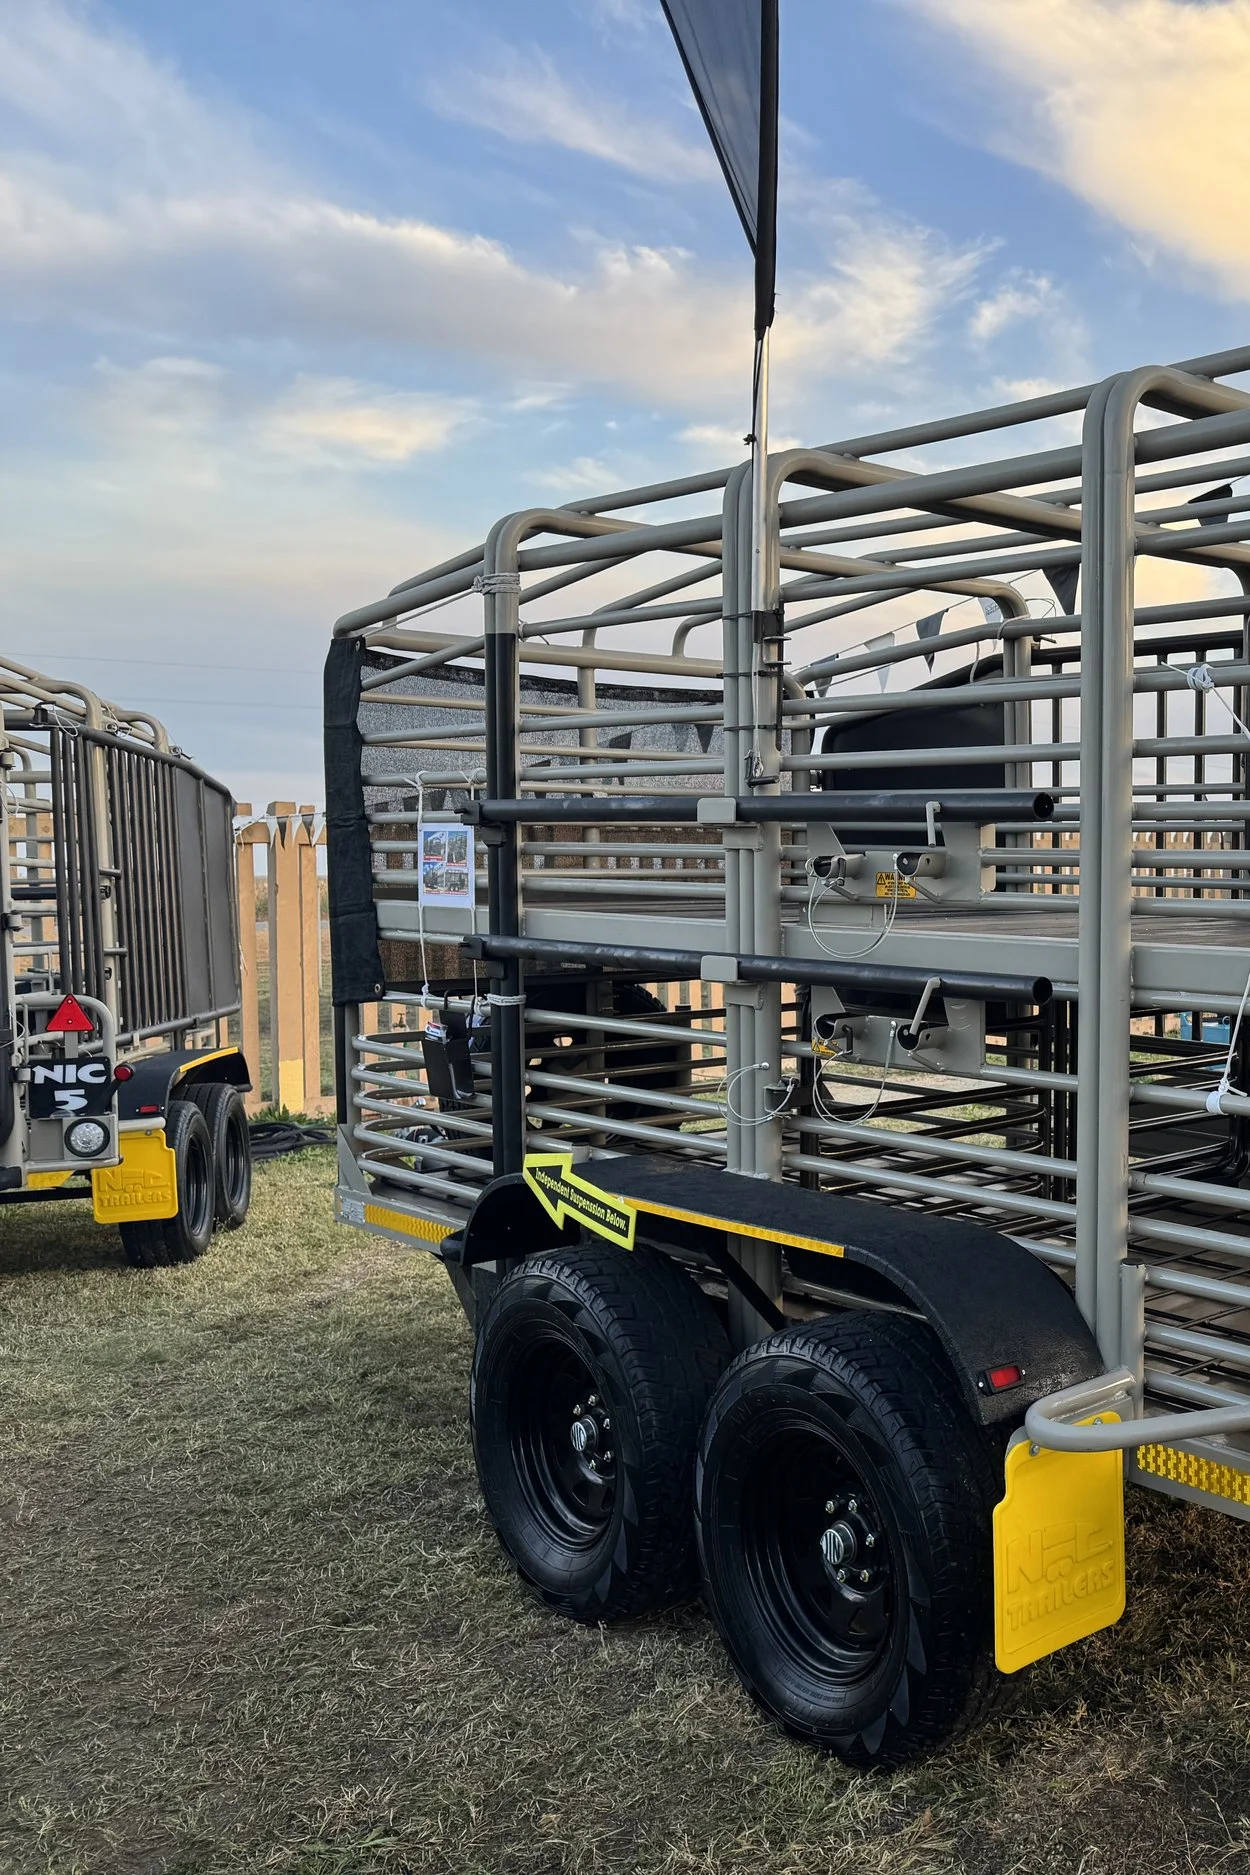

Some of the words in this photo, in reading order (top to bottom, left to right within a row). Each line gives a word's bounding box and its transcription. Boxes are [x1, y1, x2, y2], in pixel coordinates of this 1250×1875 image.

[32, 1063, 107, 1085] NIC
[54, 1089, 88, 1111] 5
[100, 1189, 171, 1208] TRAILERS
[535, 1167, 570, 1198] Independent
[605, 1208, 627, 1231] Below.
[1006, 1559, 1115, 1632] TRAILERS
